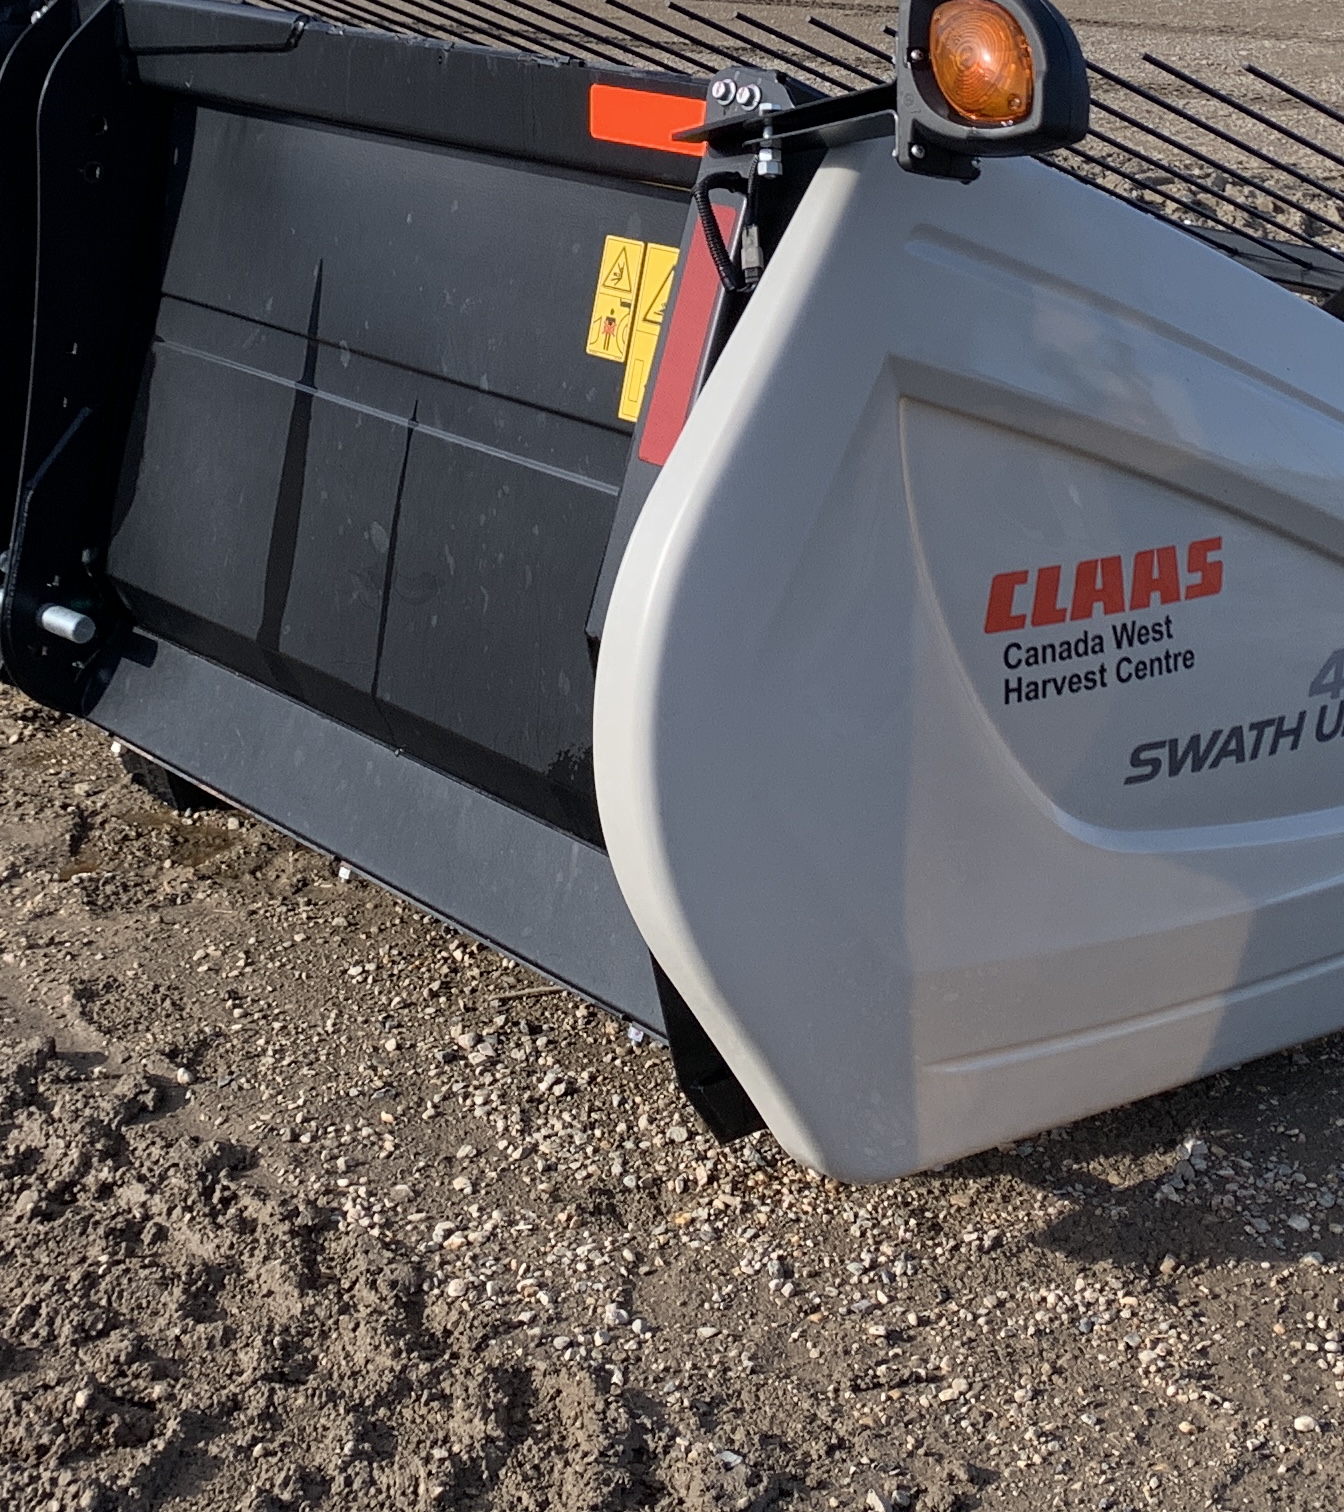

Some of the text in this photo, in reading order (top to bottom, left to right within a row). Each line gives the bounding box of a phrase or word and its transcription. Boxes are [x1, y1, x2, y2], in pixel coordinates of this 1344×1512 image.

[983, 535, 1225, 634] CLAAS
[1002, 614, 1175, 670] Canada West
[1002, 645, 1196, 705] Harvest Centre
[1123, 710, 1308, 786] SWATH
